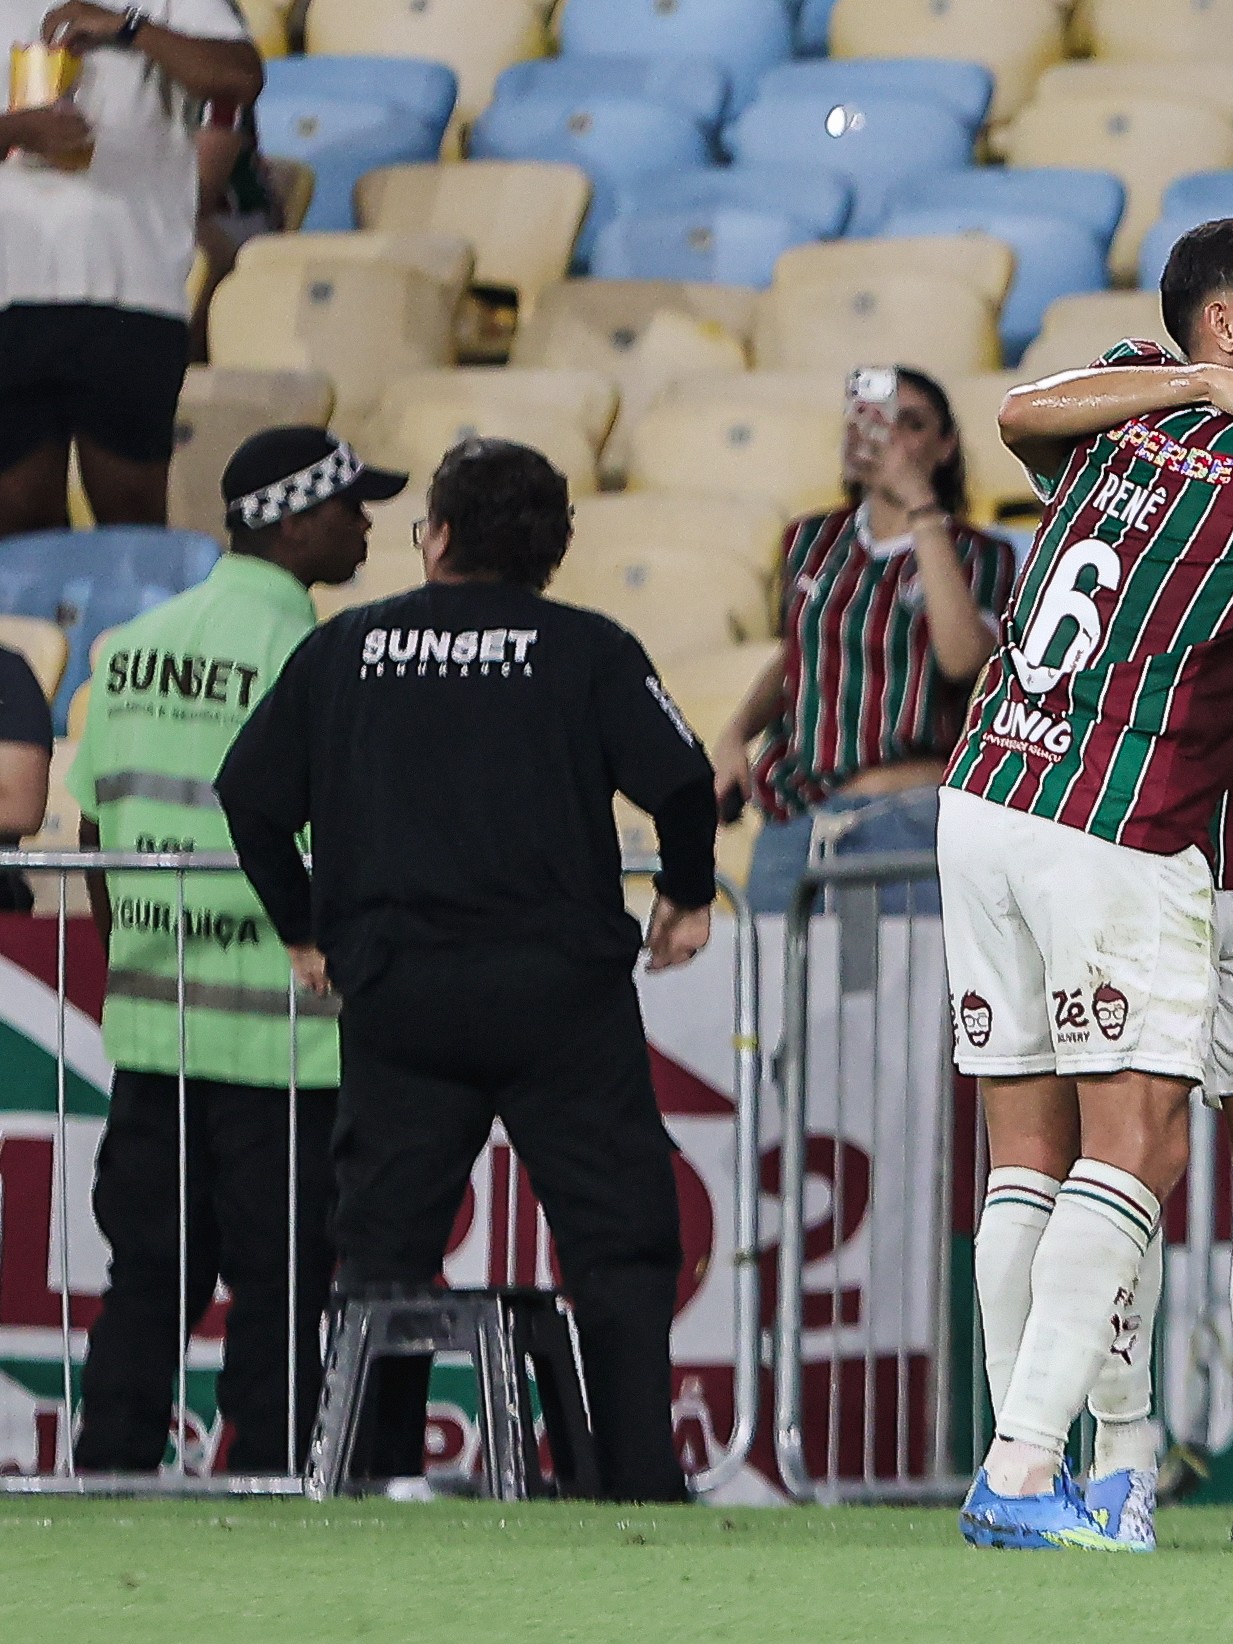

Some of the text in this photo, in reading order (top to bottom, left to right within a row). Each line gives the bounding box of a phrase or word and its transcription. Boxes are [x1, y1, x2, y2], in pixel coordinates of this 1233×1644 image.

[1093, 472, 1168, 532] RENÊ
[1010, 538, 1122, 694] 6
[362, 628, 538, 664] SUNSET
[108, 648, 258, 708] SUNSET
[993, 699, 1072, 754] UNIG
[1052, 988, 1090, 1030] Zé
